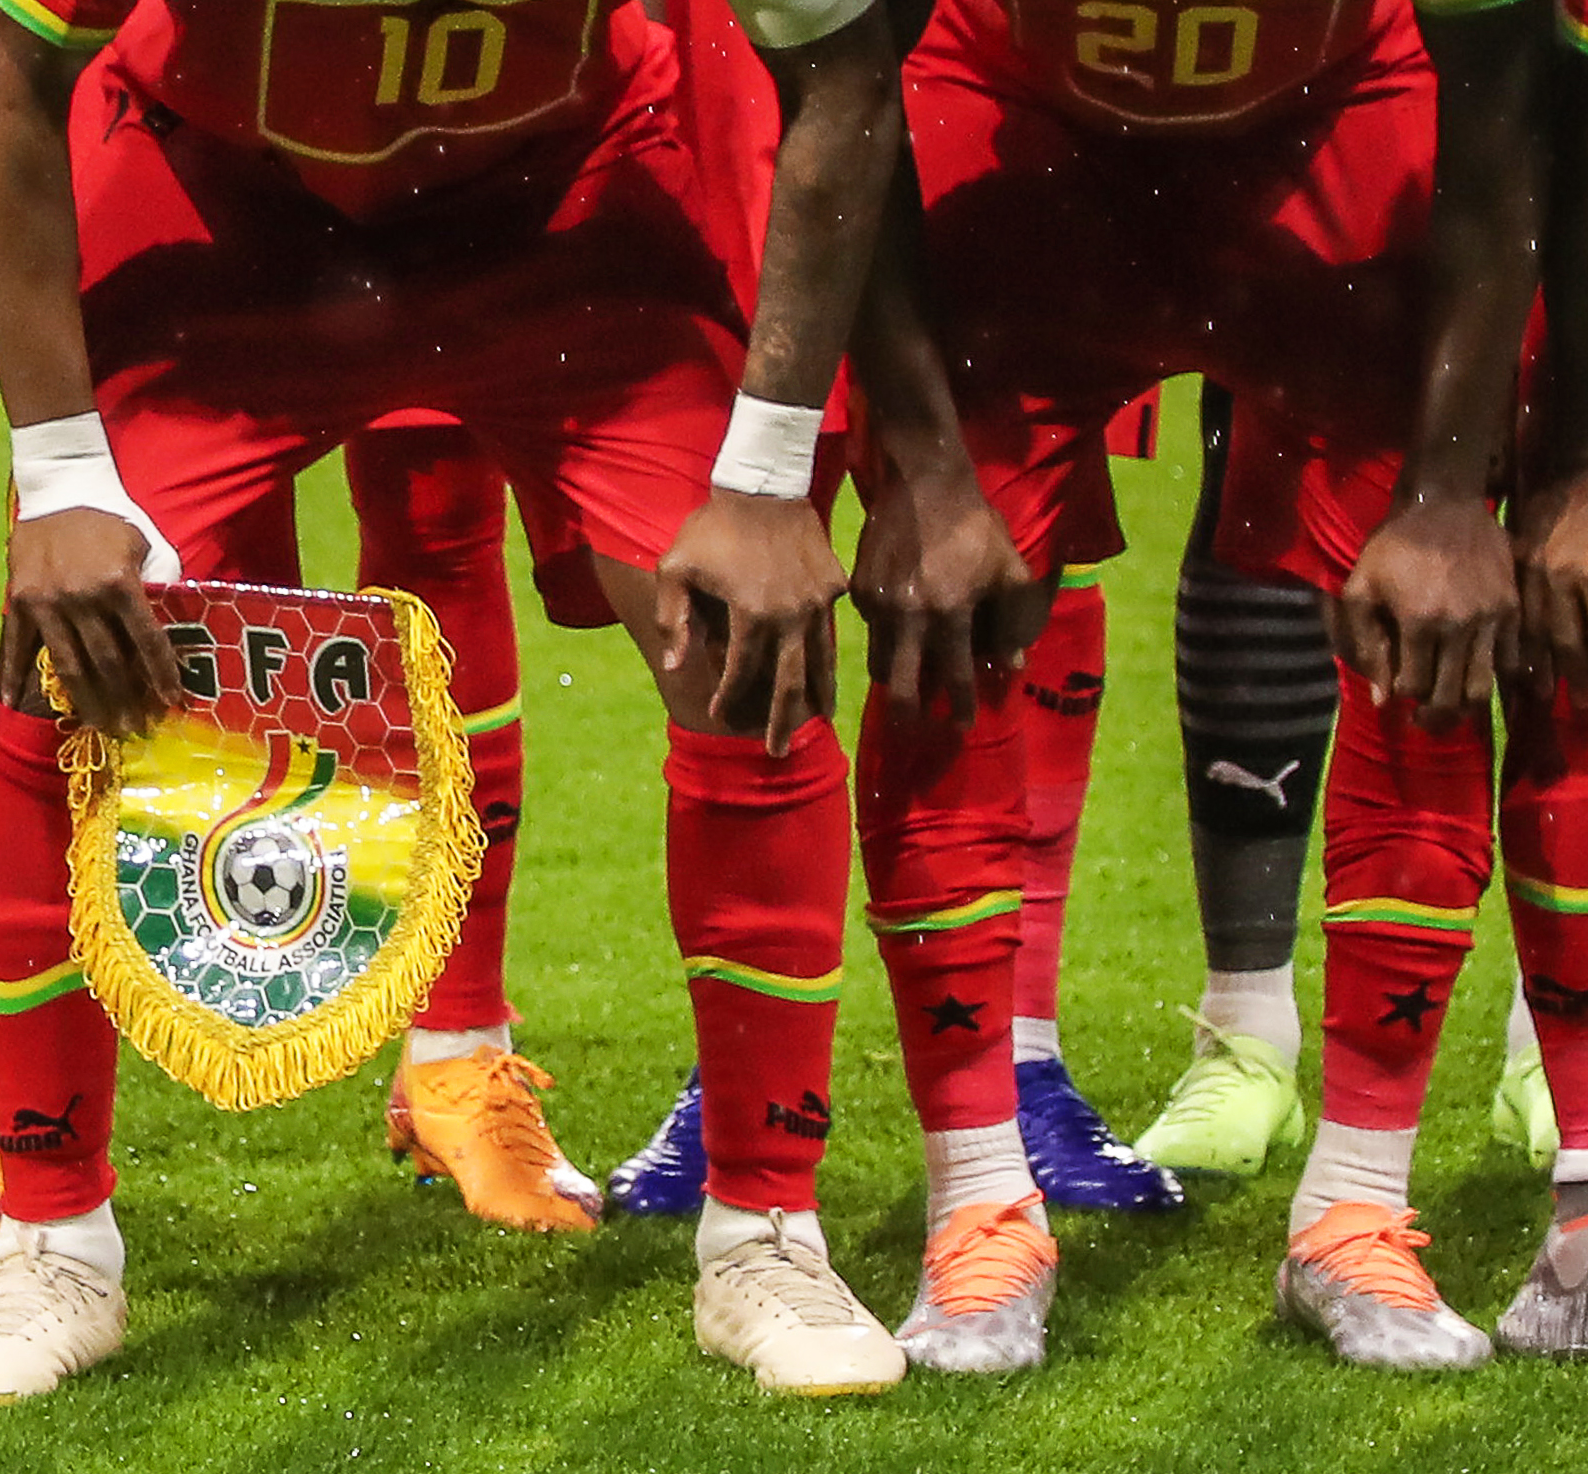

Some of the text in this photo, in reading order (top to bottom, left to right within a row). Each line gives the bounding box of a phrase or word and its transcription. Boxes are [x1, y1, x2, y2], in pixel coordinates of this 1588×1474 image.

[374, 10, 506, 106] 10
[1076, 1, 1259, 89] 20
[163, 622, 372, 716] GFA
[179, 833, 200, 912] GHANA
